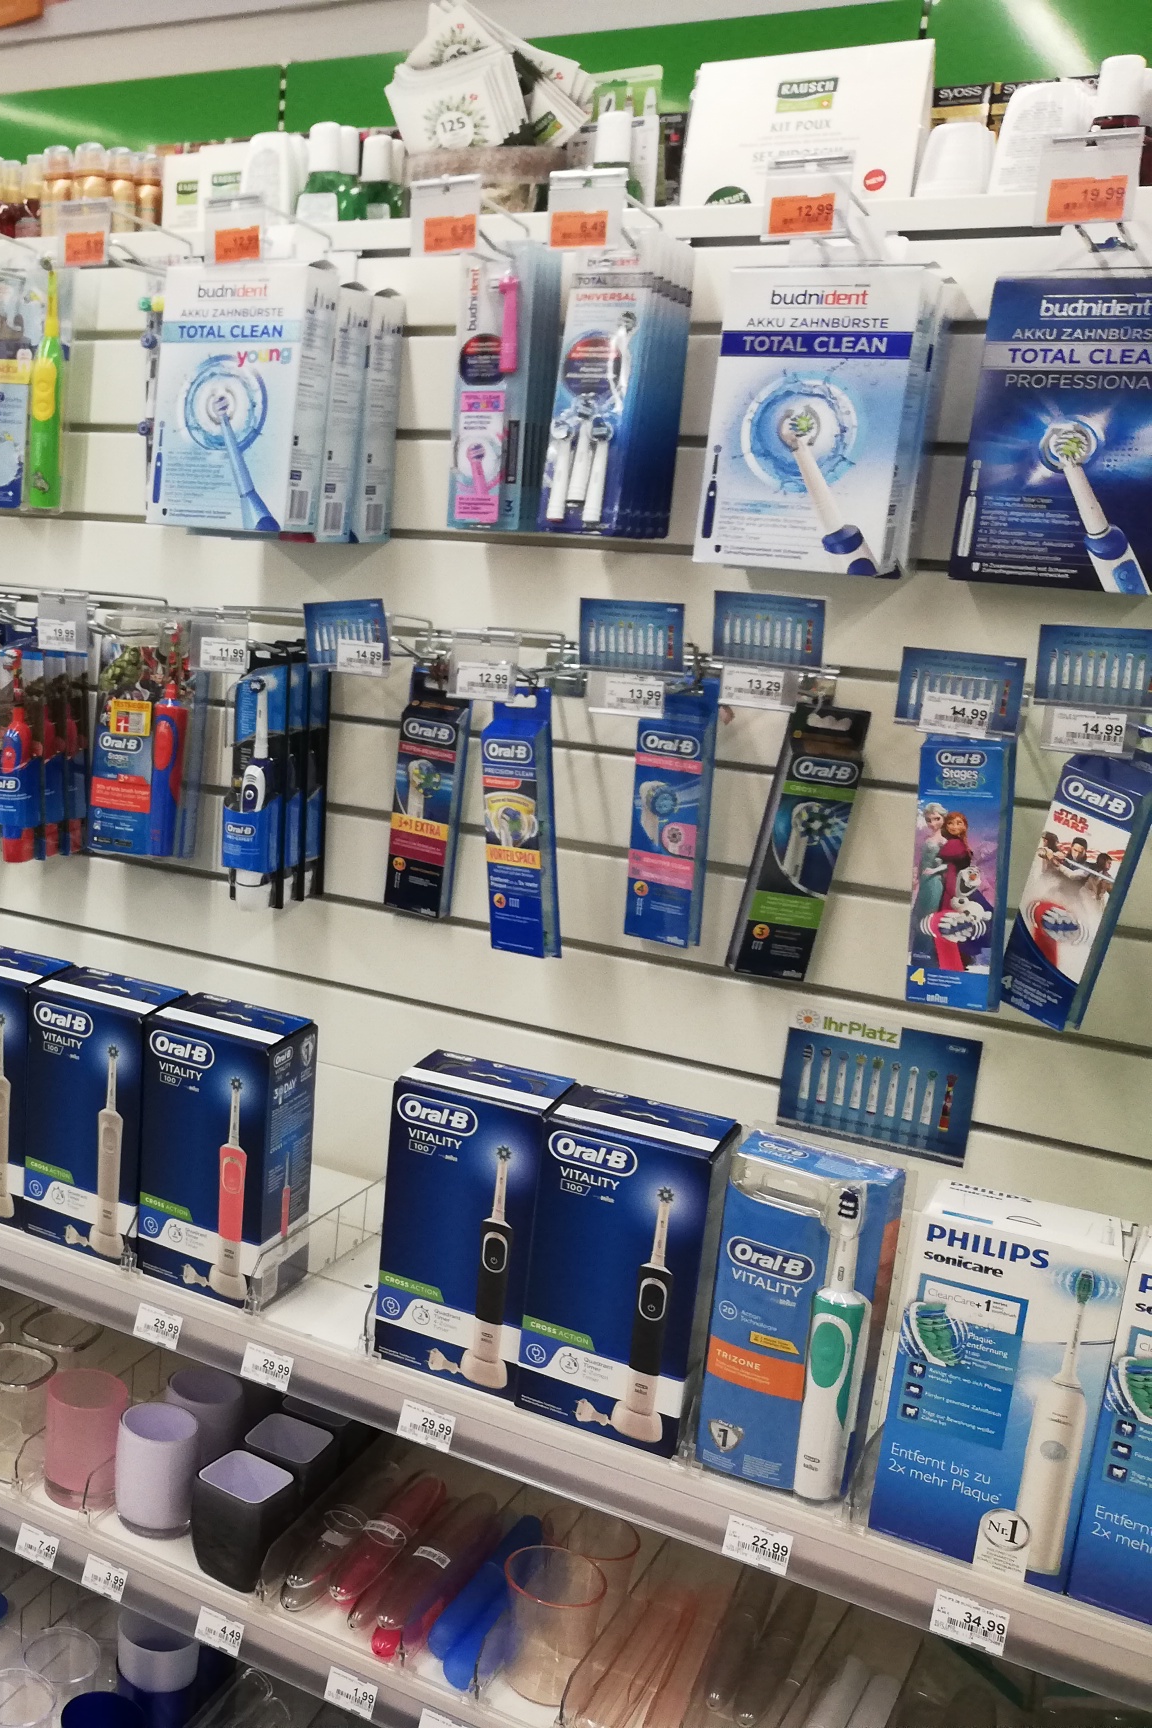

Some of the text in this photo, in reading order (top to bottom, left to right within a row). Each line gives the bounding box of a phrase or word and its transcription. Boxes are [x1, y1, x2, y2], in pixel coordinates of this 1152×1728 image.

[781, 80, 835, 95] RAUSCH
[440, 118, 466, 132] 125
[770, 119, 832, 132] KIT POUX
[198, 284, 269, 299] budnident
[467, 268, 479, 331] budnident
[771, 289, 869, 306] budnident
[181, 308, 209, 318] AKKU
[747, 315, 889, 329] AKKU ZAHNBÜRSTE
[178, 324, 284, 339] TOTAL CLEAN
[1012, 328, 1058, 340] AKKU
[743, 335, 888, 354] TOTAL CLEAN
[237, 347, 293, 368] young
[1008, 348, 1080, 364] TOTAL
[218, 647, 245, 659] 11.99
[355, 649, 382, 662] 14.99
[478, 671, 508, 685] 12.99
[747, 678, 781, 692] 13.29
[628, 688, 661, 701] 13.99
[950, 706, 988, 720] 14.99
[408, 722, 450, 740] Oral-B
[1082, 722, 1123, 736] 14.99
[102, 736, 137, 750] Oral-B
[488, 743, 529, 760] Oral-B
[646, 736, 694, 753] Oral-B
[940, 753, 981, 766] Oral-B
[799, 761, 852, 780] Oral-B
[942, 768, 979, 781] Stages
[1067, 780, 1128, 815] Oral-B
[1052, 813, 1090, 834] WARS
[1054, 808, 1088, 825] STAR
[227, 824, 252, 835] Oral-B
[397, 818, 441, 837] 3+1 EXTRA
[637, 883, 645, 894] 4
[758, 926, 765, 937] 3
[910, 968, 926, 986] 4
[1002, 975, 1013, 990] 4
[39, 1007, 87, 1032] Oral-B
[822, 1015, 899, 1046] IhrPlatz
[42, 1030, 83, 1050] VITALITY
[47, 1044, 59, 1053] 100
[155, 1036, 207, 1063] Oral-B
[275, 1049, 292, 1065] Oral-B
[159, 1061, 203, 1081] VITALITY
[163, 1076, 176, 1085] 100
[404, 1100, 469, 1129] Oral-B
[408, 1127, 463, 1150] VITALITY
[414, 1143, 429, 1153] 100
[556, 1138, 628, 1169] Oral-B
[30, 1161, 49, 1172] CROSS
[560, 1165, 620, 1191] VITALITY
[566, 1182, 583, 1193] 100
[145, 1196, 189, 1217] CROSS ACTION
[926, 1223, 1050, 1270] PHILIPS
[734, 1243, 805, 1276] Oral-B
[923, 1250, 1004, 1279] sonicare
[384, 1275, 439, 1297] CROSS ACTION
[731, 1267, 803, 1298] VITALITY
[722, 1305, 735, 1315] 2D
[740, 1309, 762, 1321] Action
[153, 1317, 180, 1335] 29.99
[530, 1321, 590, 1346] CROSS ACTION
[967, 1332, 997, 1345] Plaque-
[966, 1341, 1009, 1359] entfernung
[261, 1357, 290, 1376] 29.99
[716, 1348, 762, 1371] TRIZONE
[421, 1417, 452, 1436] 29.99
[891, 1442, 991, 1485] Entfernt bis zu
[888, 1458, 905, 1475] 2x
[909, 1468, 948, 1488] mehr
[1091, 1521, 1111, 1540] 2x
[38, 1540, 56, 1556] 7.49
[752, 1535, 789, 1557] 22.99
[105, 1572, 125, 1588] 3.99
[963, 1611, 1005, 1636] 34.99
[220, 1624, 241, 1641] 4.49
[353, 1686, 374, 1704] 1.99
